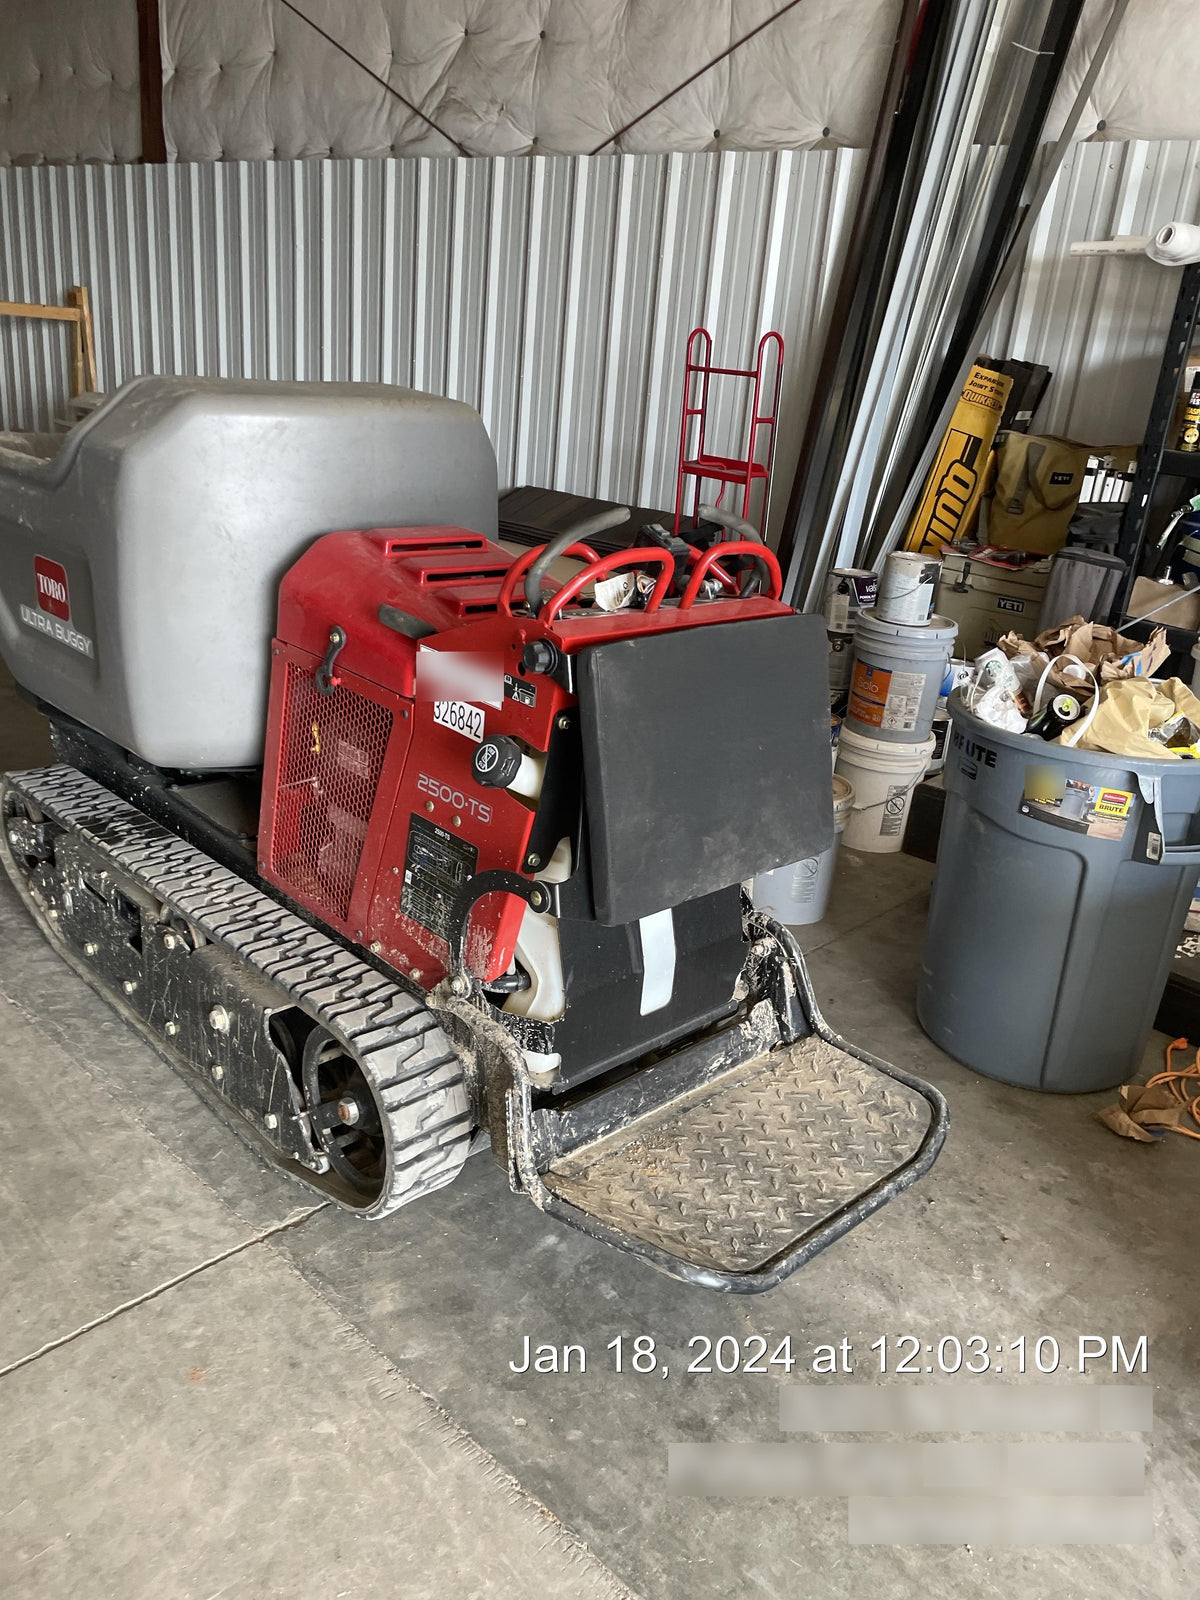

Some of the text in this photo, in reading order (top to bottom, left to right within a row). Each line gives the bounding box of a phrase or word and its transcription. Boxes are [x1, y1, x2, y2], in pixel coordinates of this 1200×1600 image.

[37, 573, 66, 603] TORO
[999, 599, 1023, 612] YETI
[20, 605, 92, 654] ULTRA BUGGY
[434, 700, 482, 739] 326842
[1098, 803, 1124, 814] BRUTE
